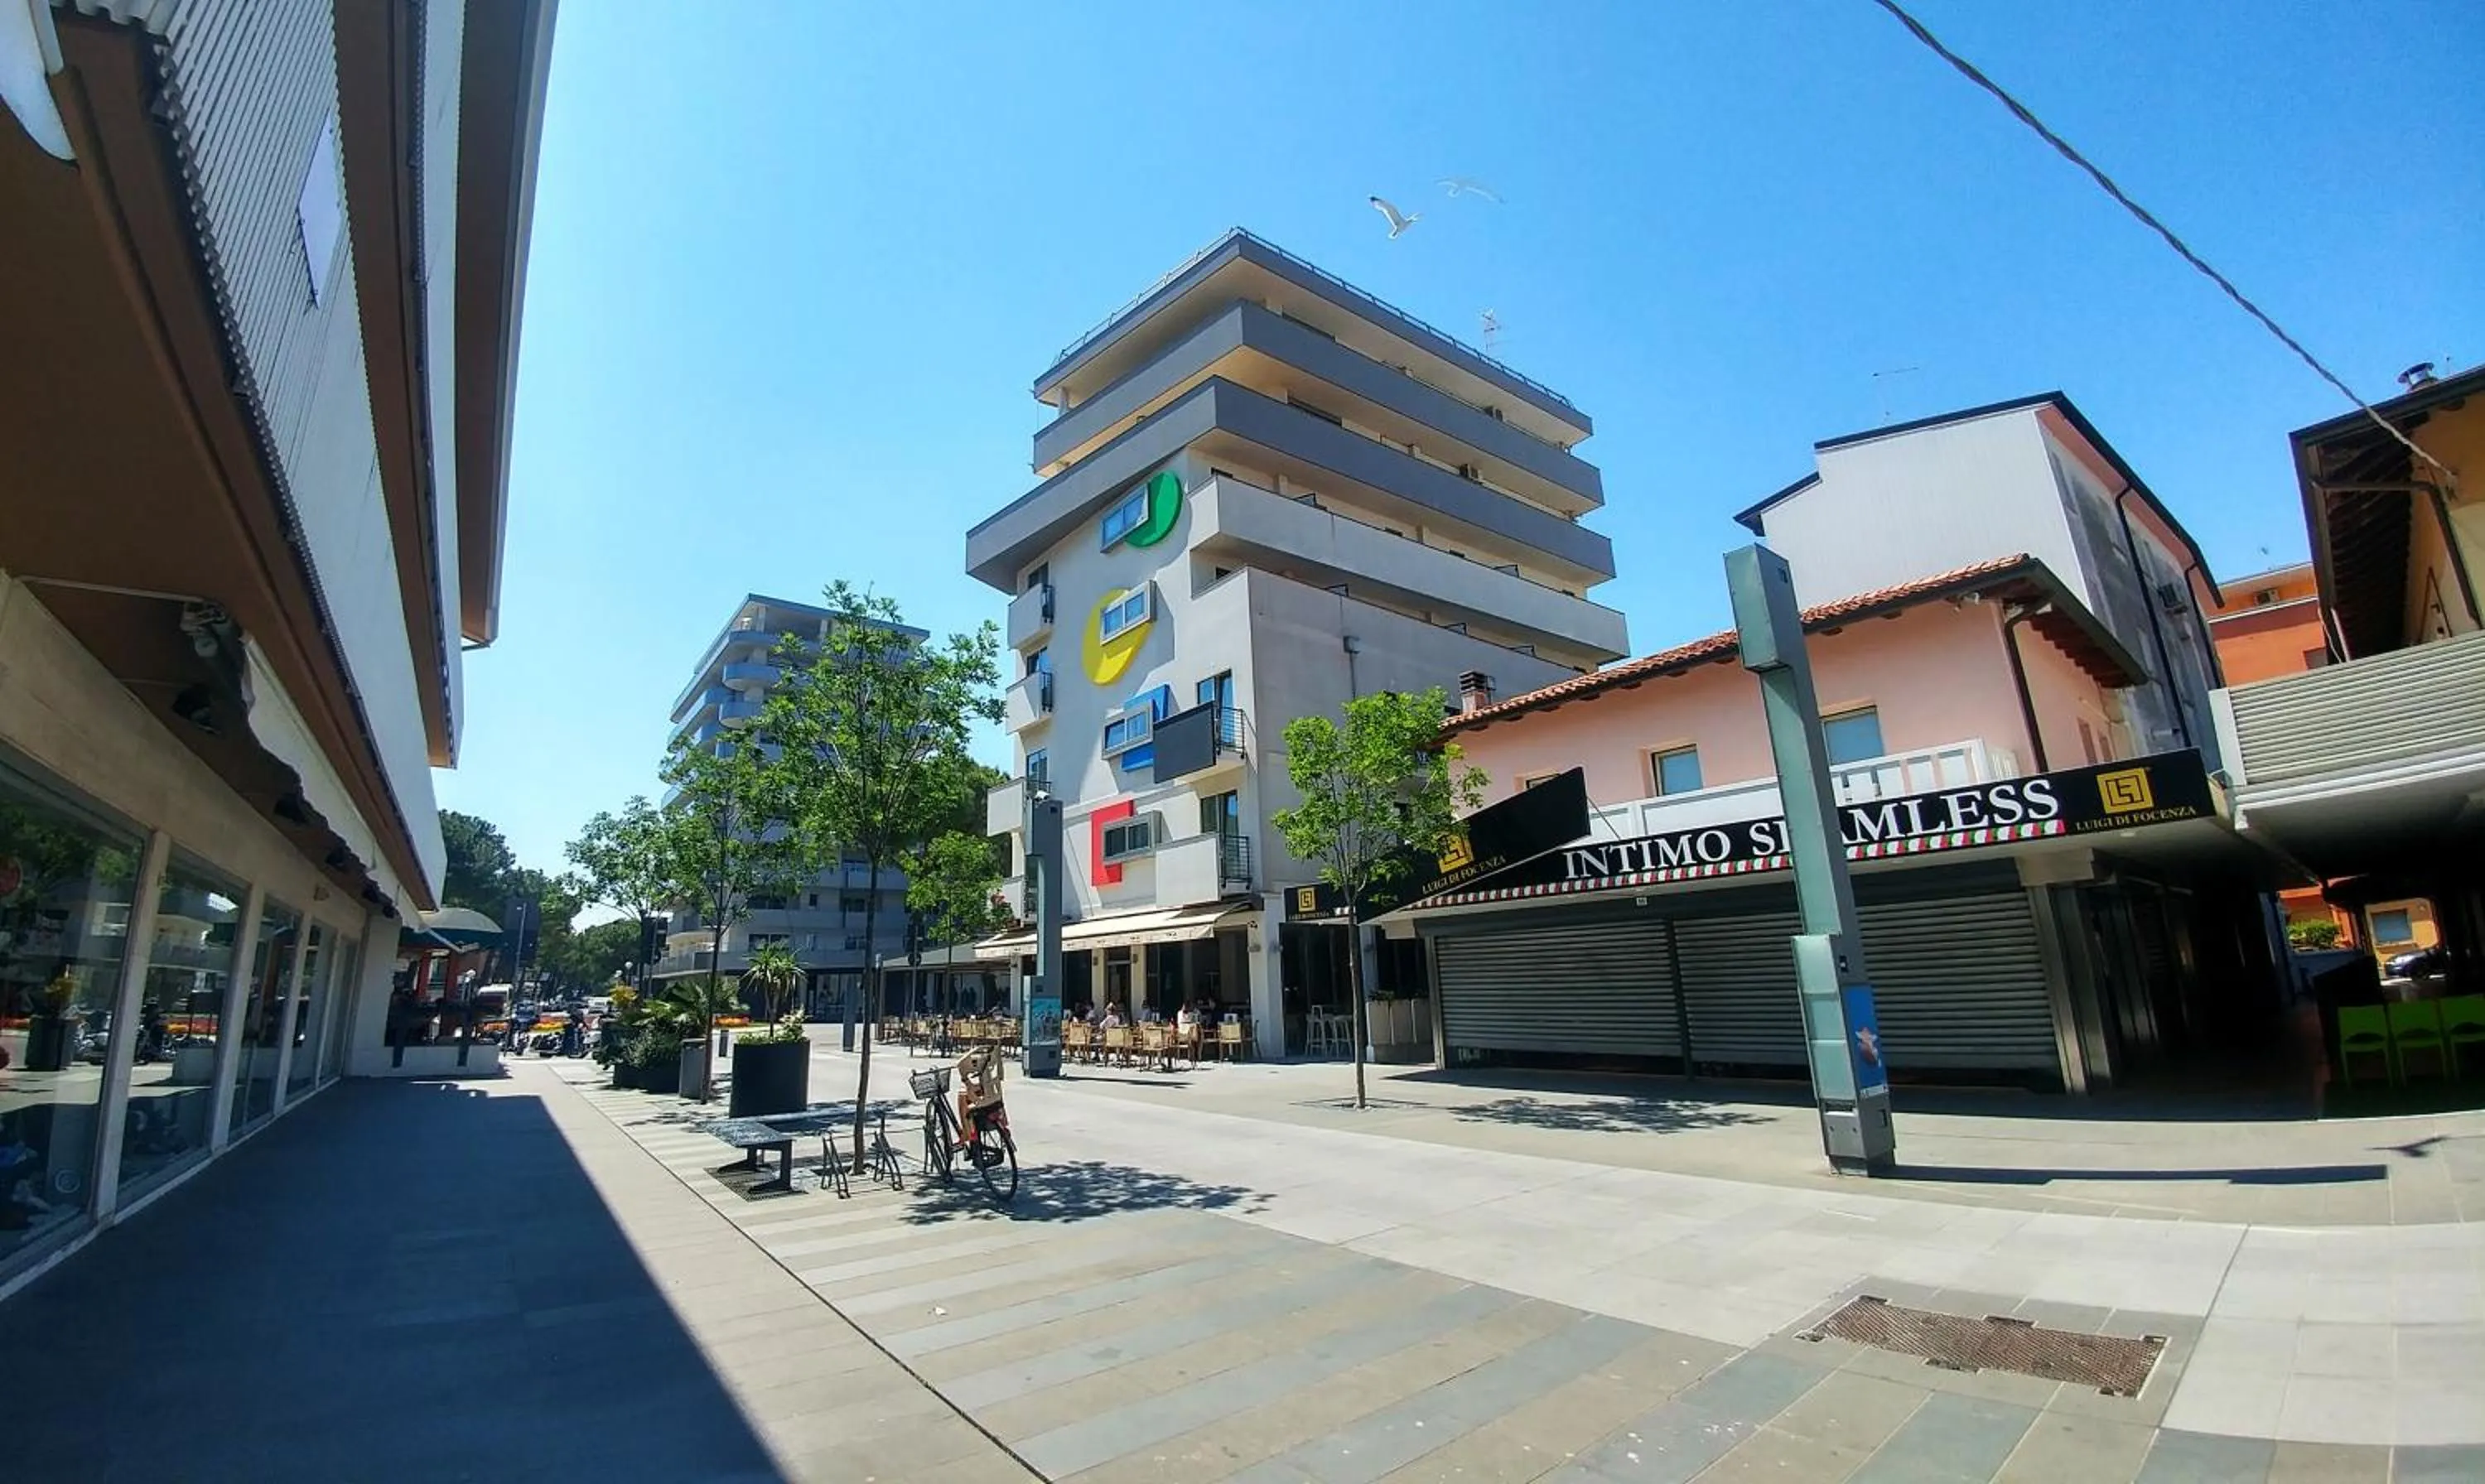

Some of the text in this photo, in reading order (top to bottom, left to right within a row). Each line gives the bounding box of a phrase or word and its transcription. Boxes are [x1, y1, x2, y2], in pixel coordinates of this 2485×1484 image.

[1564, 778, 2060, 880] INTIMO SMLESS
[2075, 805, 2197, 831] LUIGI DI FOCENZA
